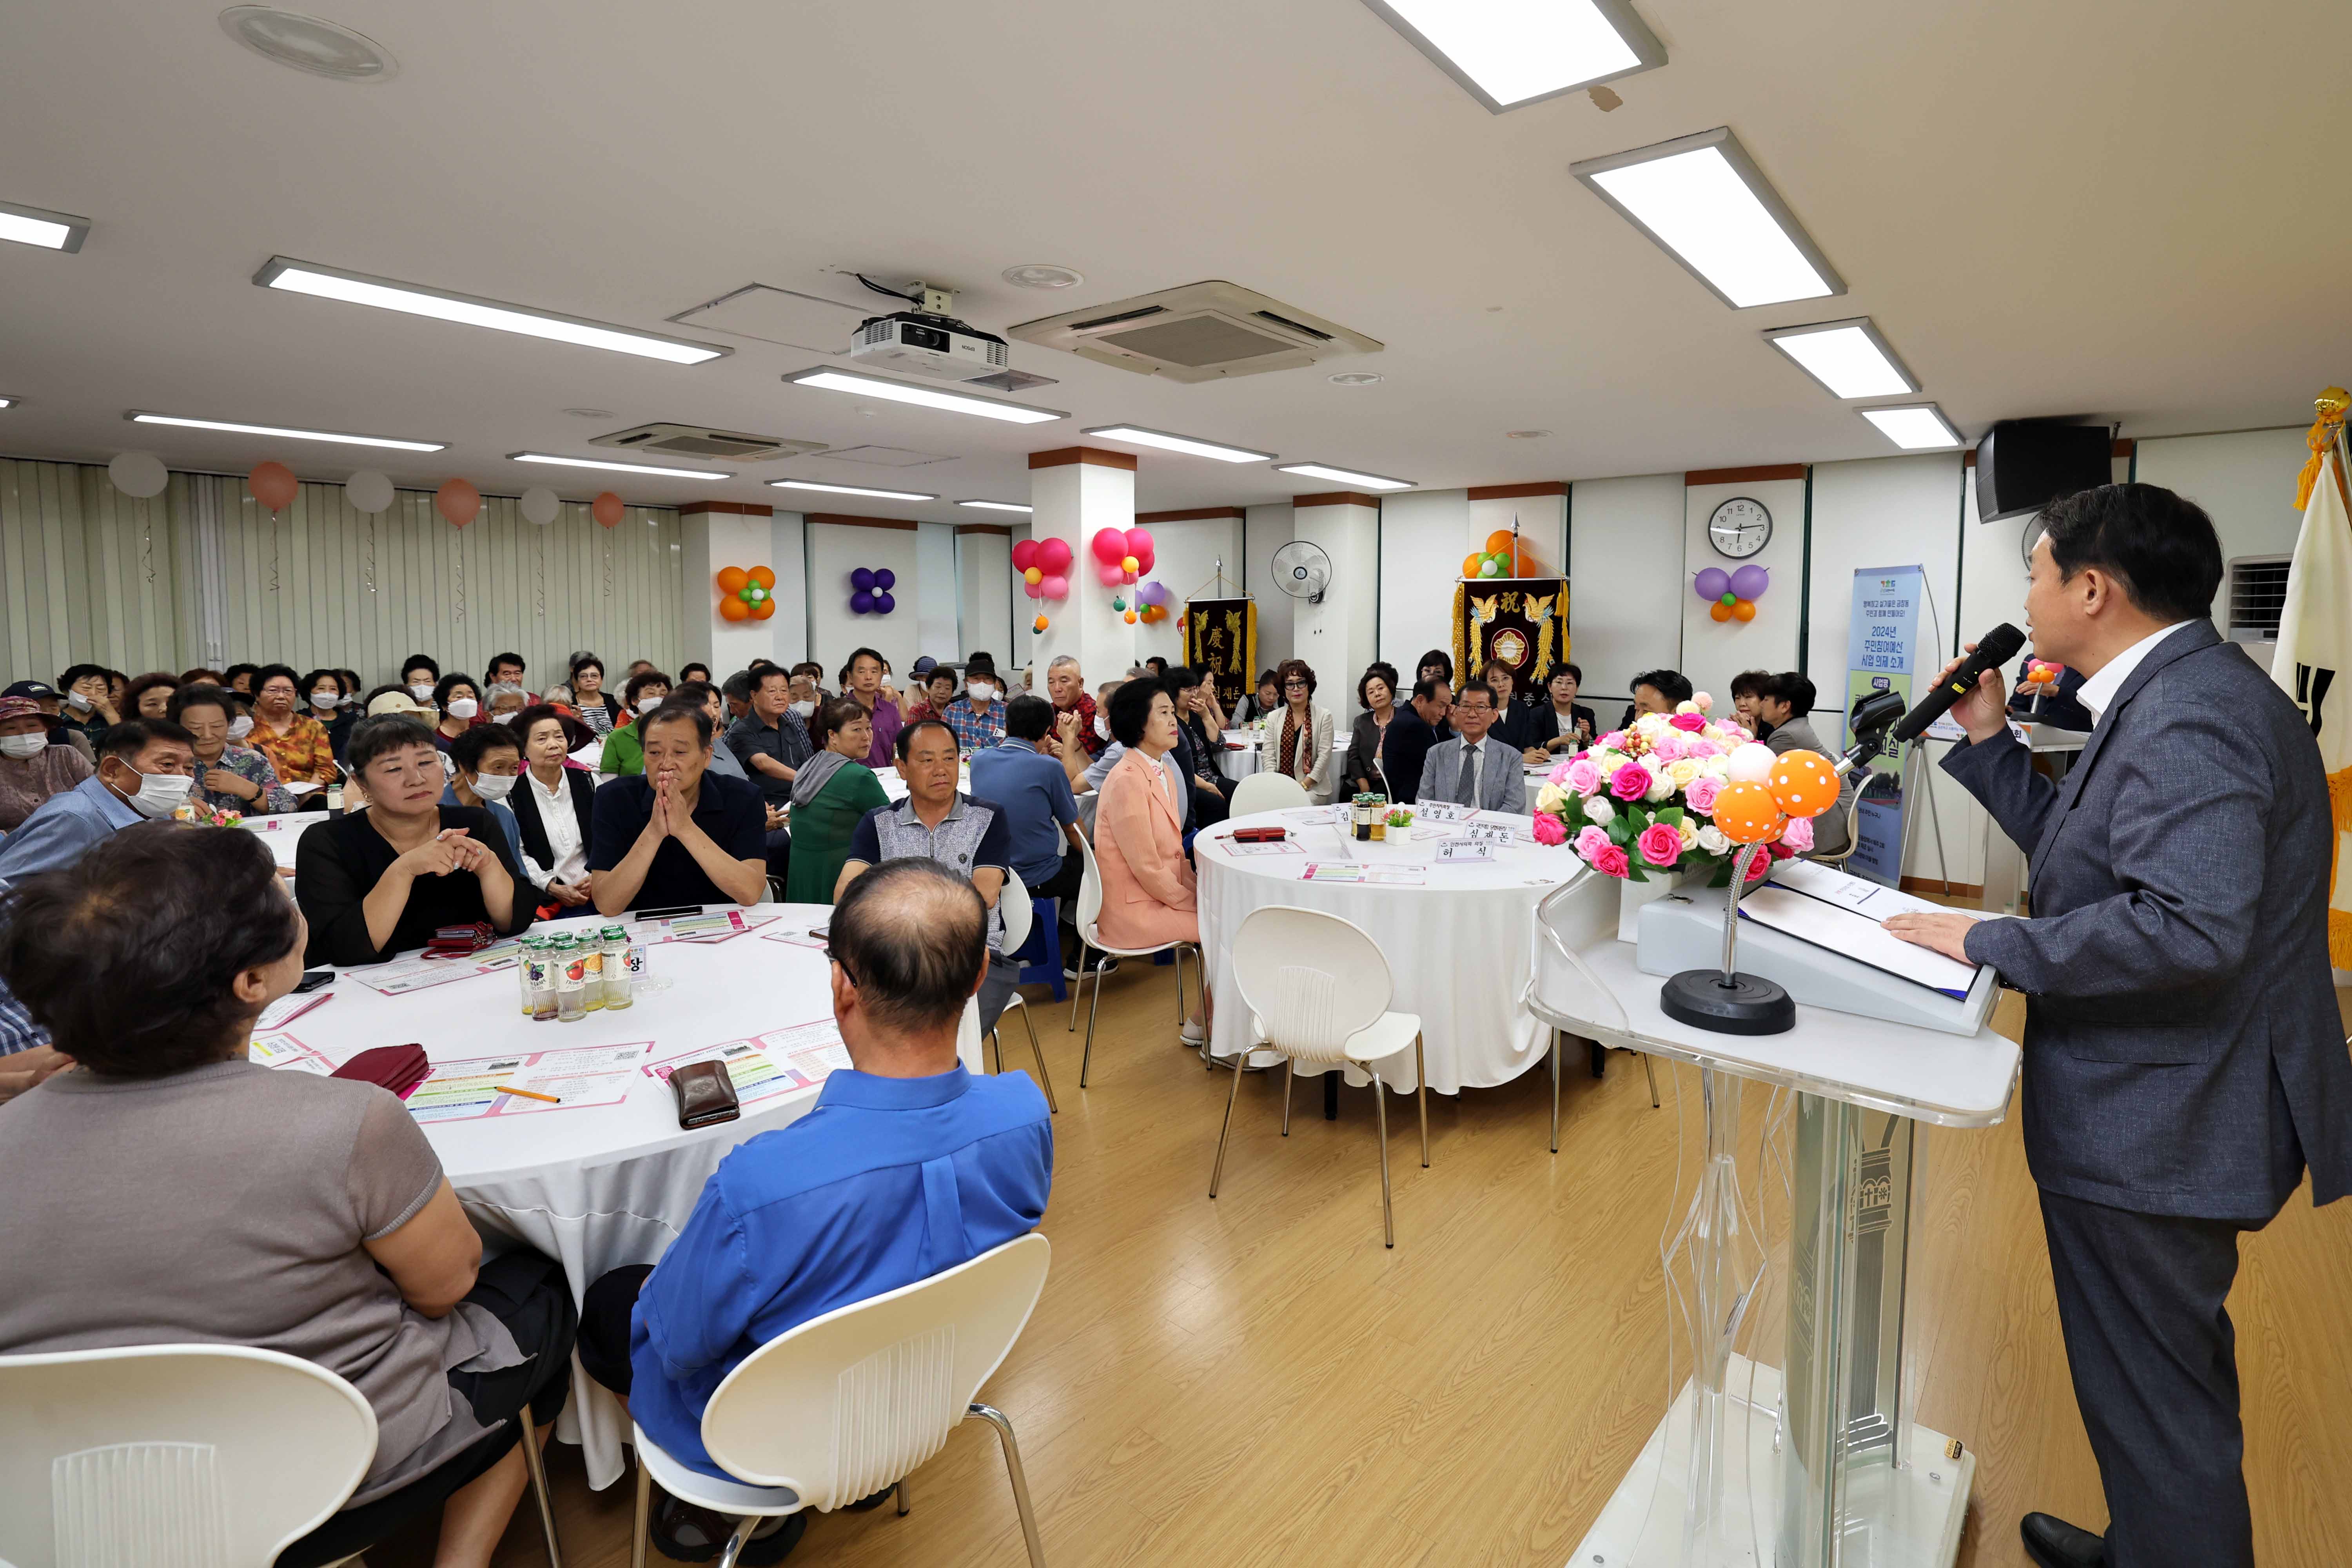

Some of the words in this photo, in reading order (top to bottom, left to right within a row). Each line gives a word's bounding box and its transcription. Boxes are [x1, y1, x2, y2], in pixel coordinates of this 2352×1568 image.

[1500, 591, 1520, 613] 祝
[1872, 626, 1896, 638] 2024년
[1864, 640, 1903, 653] 주민참여예산
[1862, 654, 1874, 666] 사업
[1875, 655, 1888, 667] 의제
[1890, 656, 1904, 669] 소개
[1873, 678, 1889, 688] 사업명
[1339, 811, 1348, 822] 김
[1421, 808, 1428, 817] 설
[1434, 809, 1441, 819] 영
[1499, 832, 1509, 843] 돈
[1443, 848, 1452, 858] 허
[1475, 846, 1486, 857] 식
